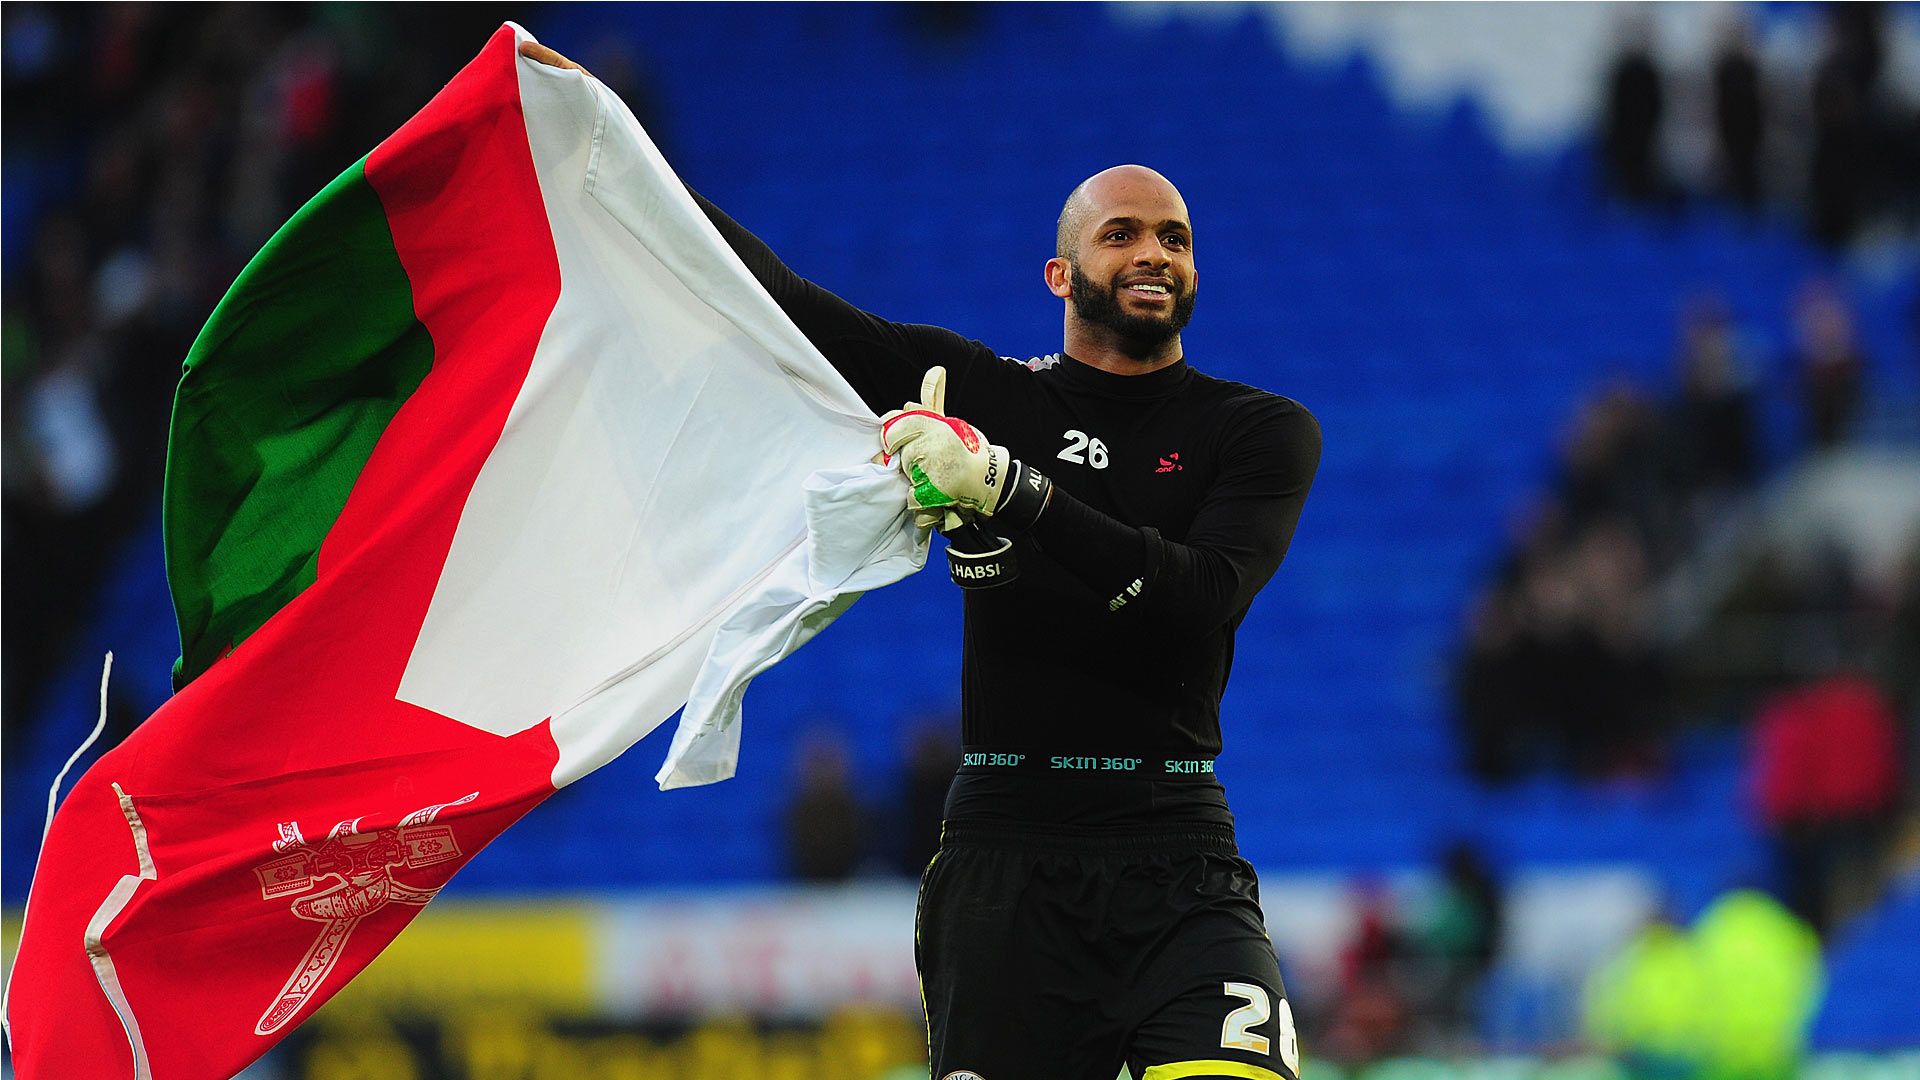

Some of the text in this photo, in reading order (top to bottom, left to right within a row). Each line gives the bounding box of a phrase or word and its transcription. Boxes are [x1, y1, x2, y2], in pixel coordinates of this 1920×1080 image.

[1057, 429, 1109, 469] 26
[955, 562, 1000, 579] HABSI
[963, 753, 1026, 766] SKIN 360°
[1051, 756, 1142, 771] SKIN 360°
[1165, 760, 1199, 774] SKIN
[1220, 982, 1300, 1079] 26
